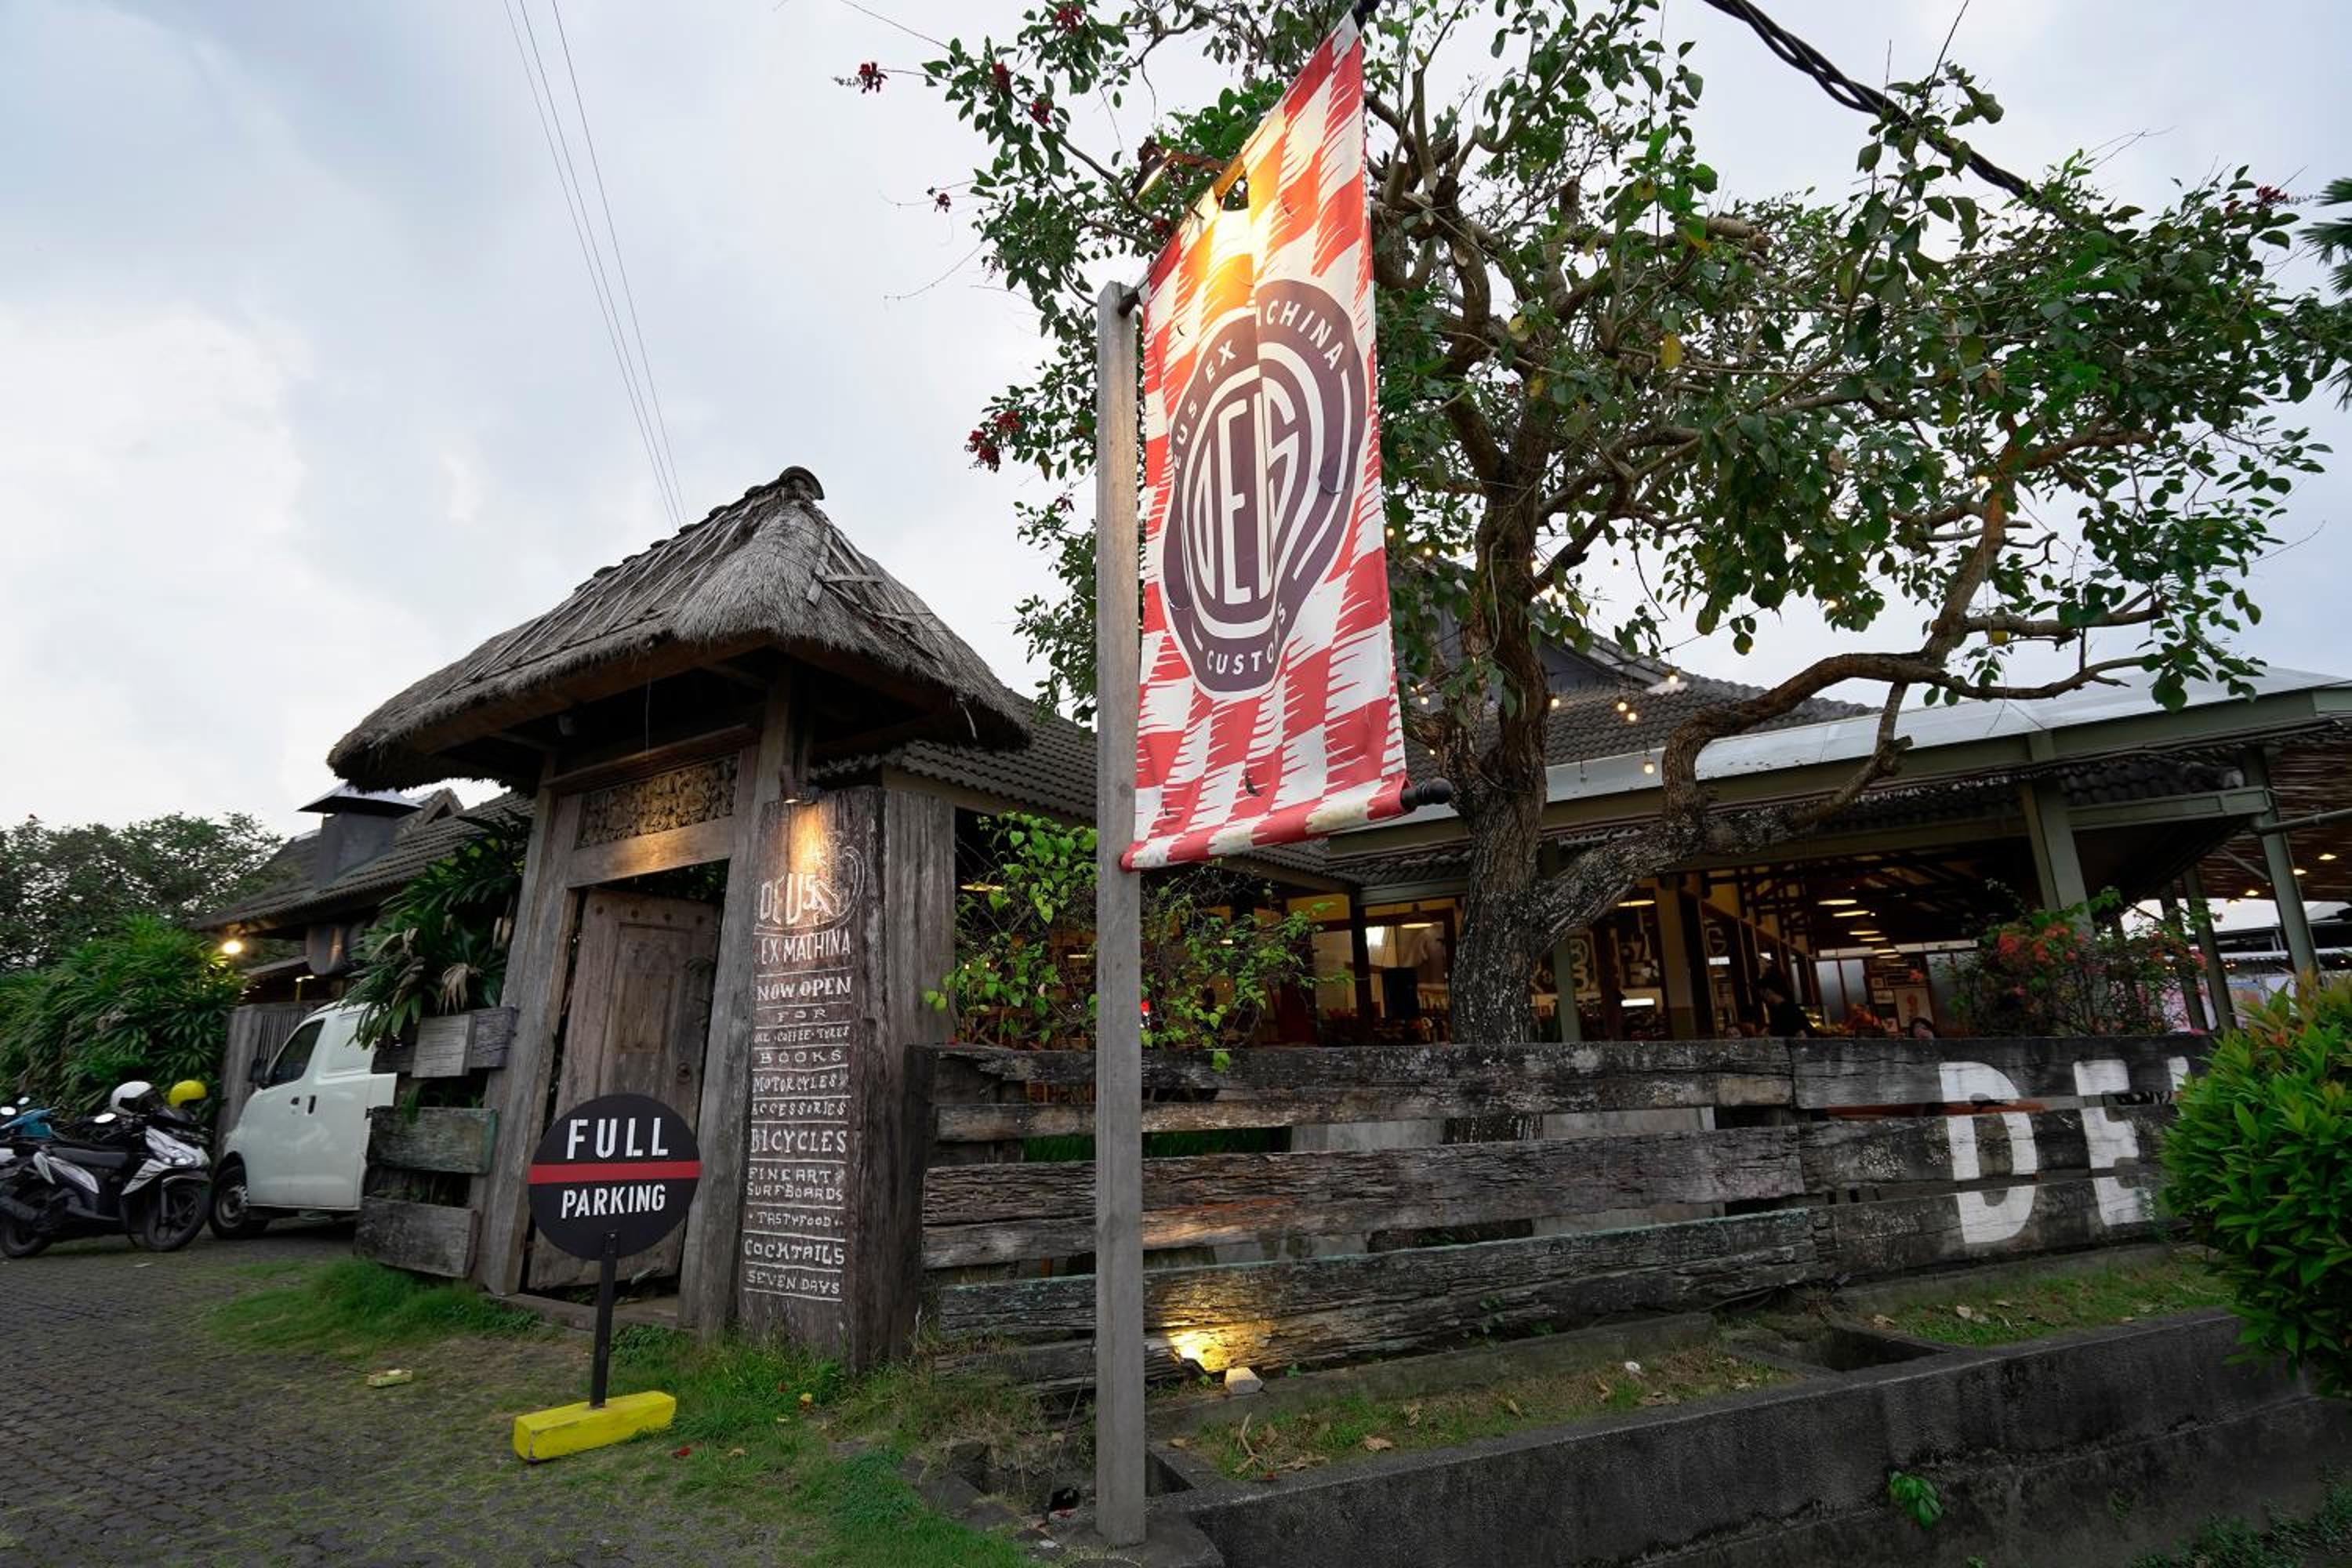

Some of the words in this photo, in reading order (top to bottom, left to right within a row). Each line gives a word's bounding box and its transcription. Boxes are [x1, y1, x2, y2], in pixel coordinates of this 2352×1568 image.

[1205, 339, 1236, 383] EX
[761, 938, 779, 964] EX
[784, 927, 851, 963] MACHINA
[757, 982, 796, 1001] NOW
[799, 976, 853, 997] OPEN
[777, 1007, 826, 1023] FOR
[777, 1029, 811, 1042] COFFEE
[760, 1049, 842, 1064] BOOKS
[751, 1101, 847, 1117] ACCESSORIES
[567, 1117, 669, 1160] FULL
[750, 1128, 848, 1153] BICYCLES
[748, 1167, 791, 1181] FINE
[796, 1169, 832, 1184] ART
[561, 1184, 666, 1219] PARKING
[746, 1181, 844, 1201] SURFBOARDS
[745, 1239, 844, 1265] COCKTAILS
[747, 1269, 797, 1290] SEVEN
[801, 1277, 840, 1294] DAYS
